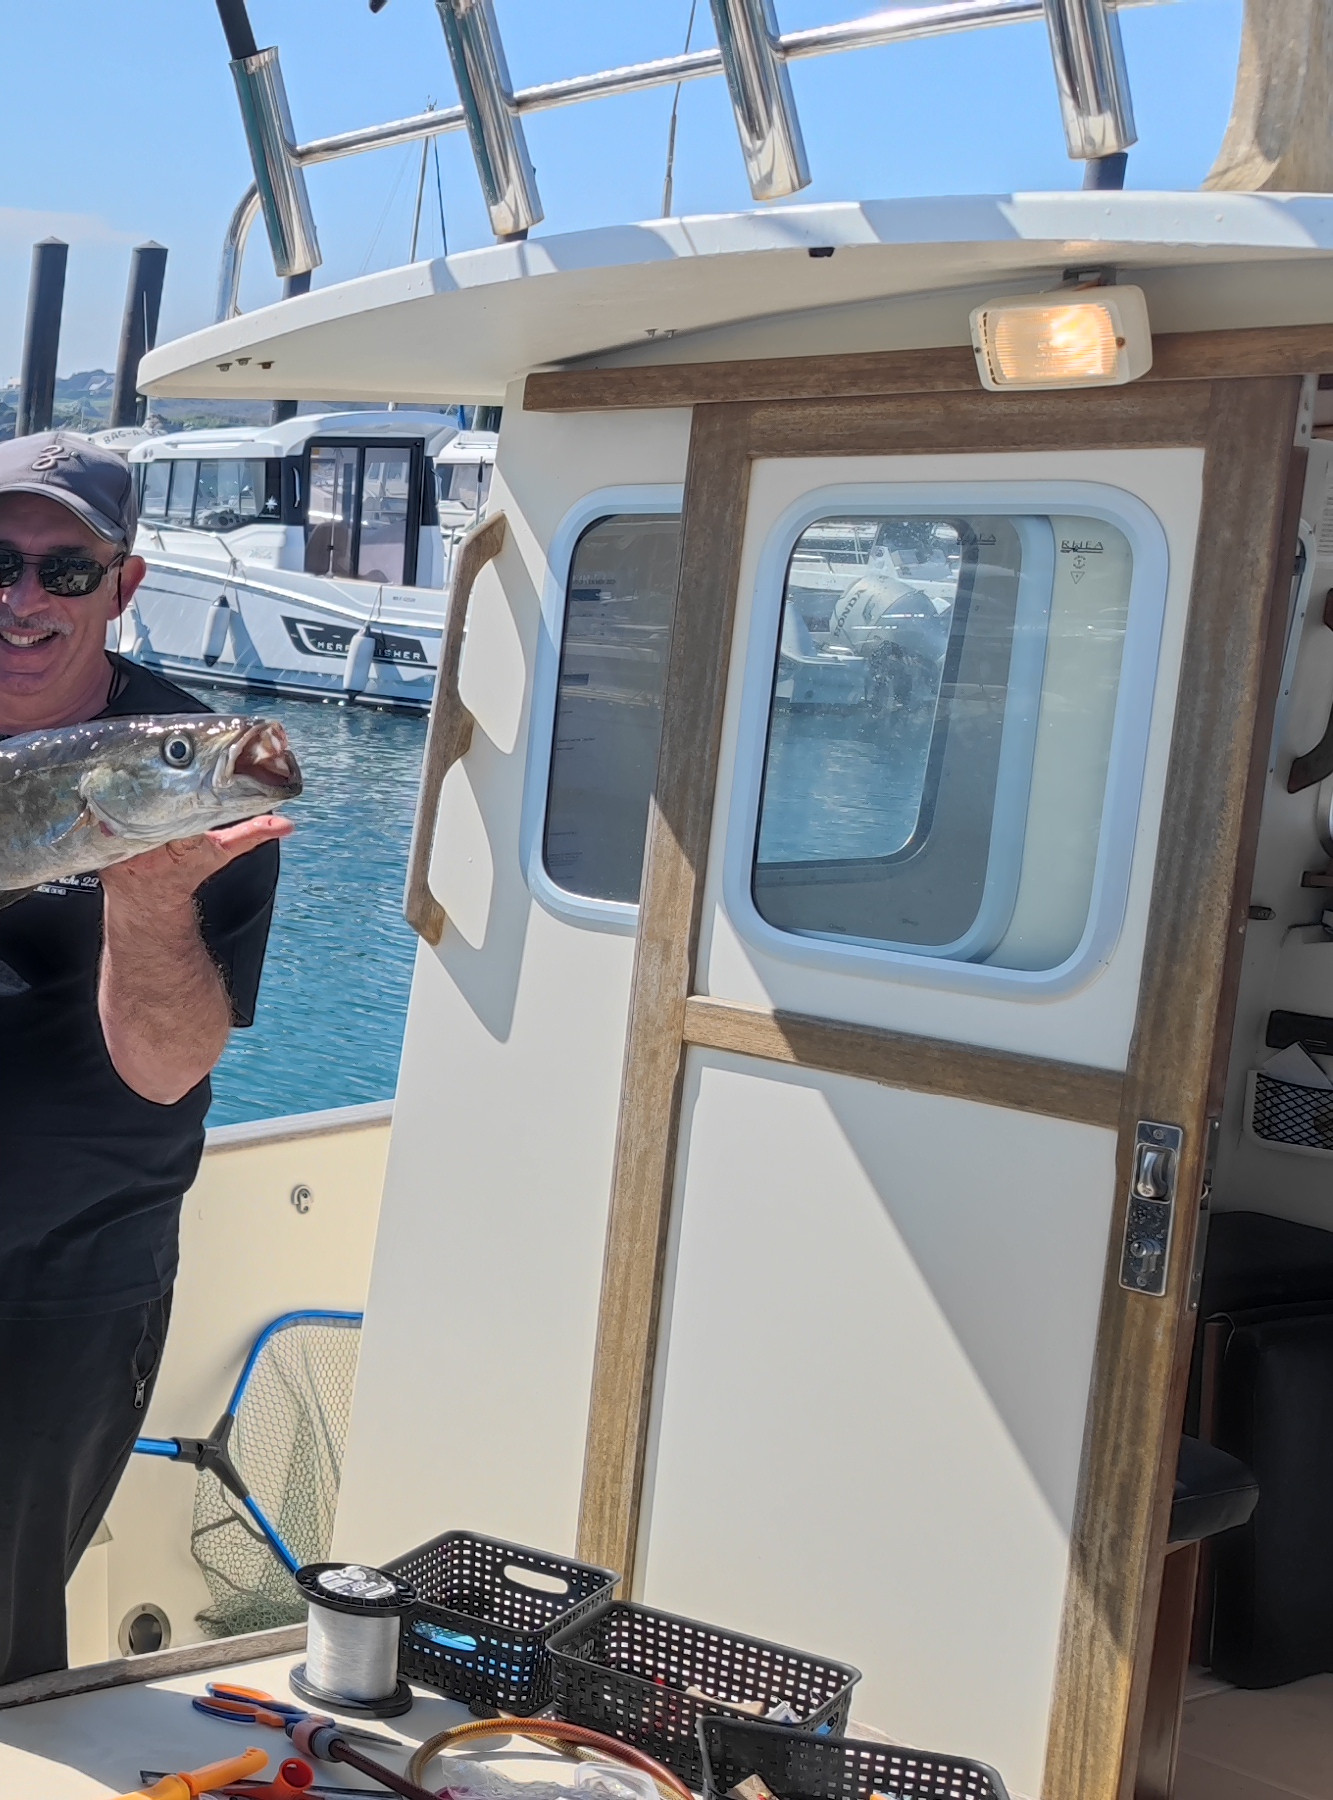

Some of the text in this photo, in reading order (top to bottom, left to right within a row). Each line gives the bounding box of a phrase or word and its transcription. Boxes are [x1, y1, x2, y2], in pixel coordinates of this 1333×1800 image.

[833, 589, 868, 638] HONDA
[317, 641, 421, 660] MERR ISHER
[81, 876, 100, 888] 22
